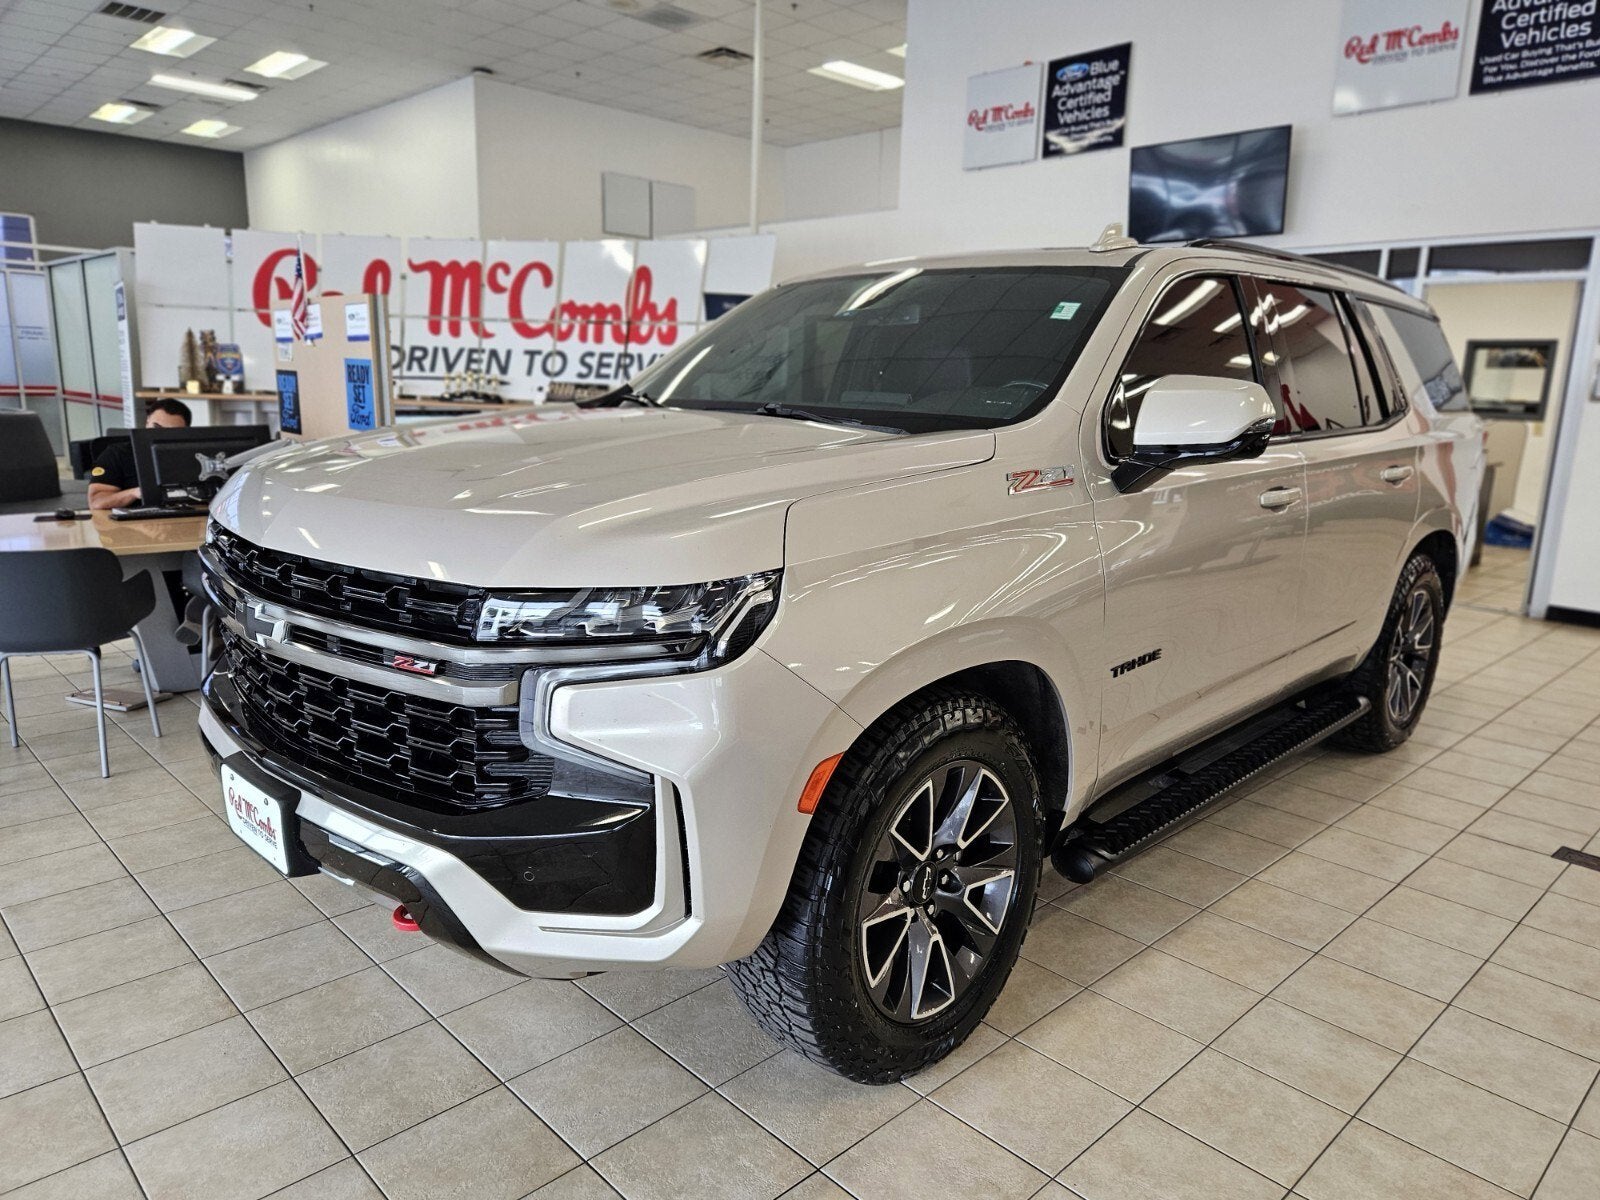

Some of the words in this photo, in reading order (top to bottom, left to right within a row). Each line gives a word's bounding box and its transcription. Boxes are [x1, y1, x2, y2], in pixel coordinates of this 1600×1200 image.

[1501, 0, 1596, 30] Certified
[1344, 35, 1379, 64] Red
[1382, 20, 1459, 52] McCombs
[1501, 21, 1592, 48] Vehicles
[1483, 65, 1498, 73] For
[1520, 57, 1560, 68] Discover
[1561, 53, 1577, 61] the
[1578, 48, 1600, 59] Ford
[1504, 52, 1520, 60] Car
[1521, 47, 1553, 58] Buying
[1555, 41, 1583, 52] That's
[1090, 60, 1119, 75] Blue
[1482, 75, 1503, 85] Blue
[1504, 68, 1554, 80] Advantage
[1555, 61, 1597, 73] Benefits.
[1057, 90, 1112, 110] Certified
[967, 110, 987, 131] Red
[991, 102, 1035, 122] McCombs
[1057, 106, 1110, 125] Vehicles
[407, 257, 679, 347] McCombs
[346, 364, 370, 385] READY
[523, 349, 568, 378] TO
[576, 351, 664, 381] SERV
[353, 384, 366, 404] SET
[350, 403, 372, 427] Ford
[1006, 465, 1075, 496] Z71
[393, 655, 437, 676] Z71
[1110, 648, 1162, 678] TAHOE
[228, 786, 244, 820] Red
[242, 798, 277, 841] McCombs
